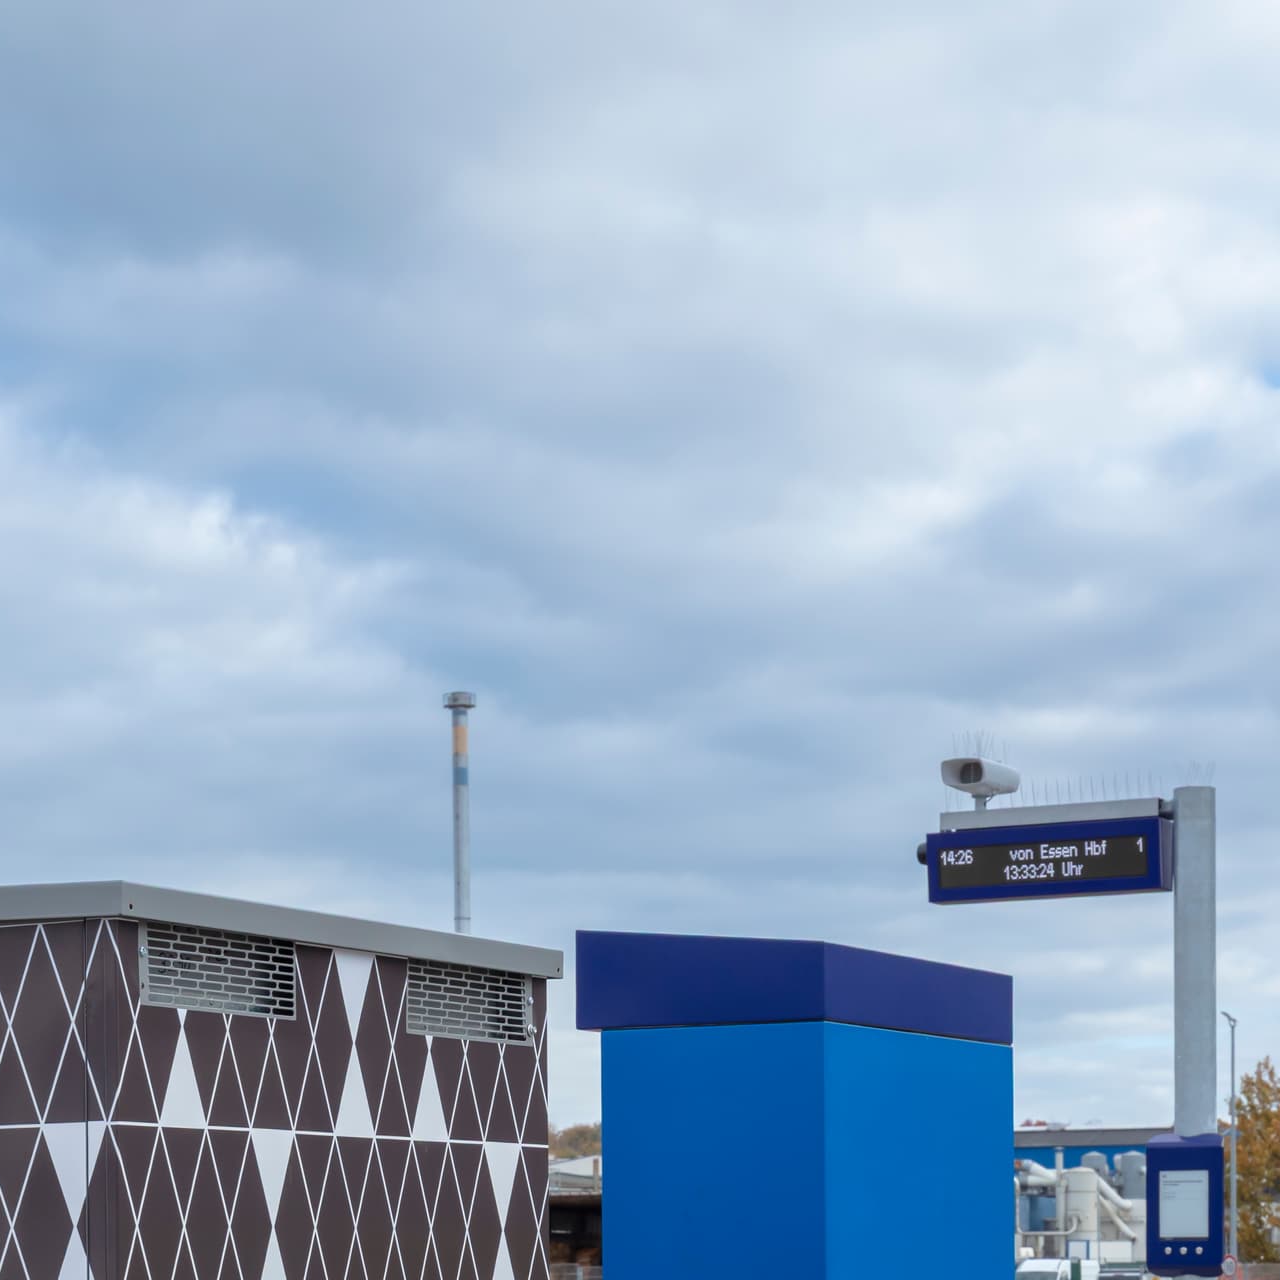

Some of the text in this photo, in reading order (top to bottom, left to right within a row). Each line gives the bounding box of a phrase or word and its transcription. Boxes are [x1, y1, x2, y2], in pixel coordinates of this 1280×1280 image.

[940, 837, 1144, 866] 14:26 von Essen Hbf 1
[1003, 862, 1084, 880] 13:33:24 Uhr
